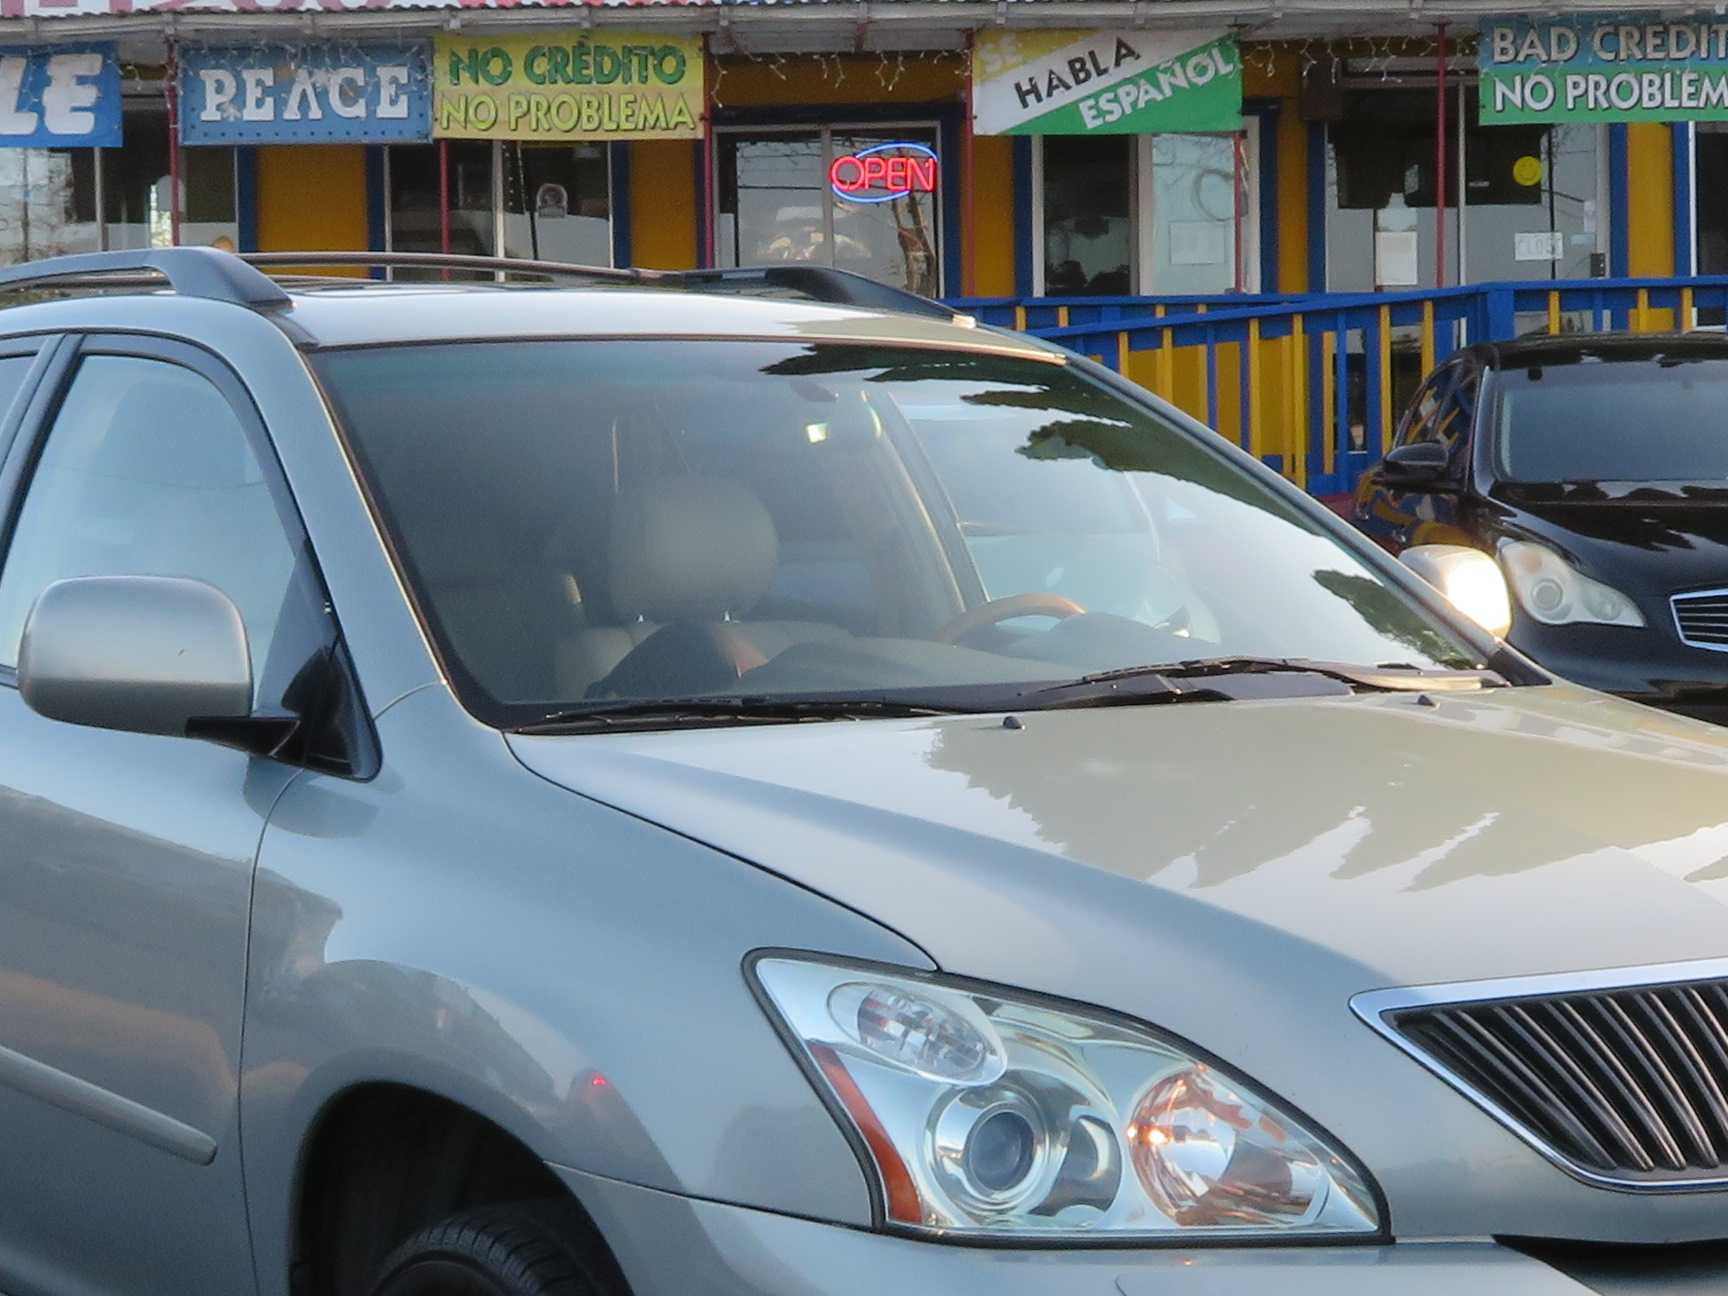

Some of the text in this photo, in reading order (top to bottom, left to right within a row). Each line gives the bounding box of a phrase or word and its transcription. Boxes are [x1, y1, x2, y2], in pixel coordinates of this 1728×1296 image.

[1491, 25, 1578, 63] BAD
[449, 47, 513, 86] NO
[1013, 37, 1141, 110] HABLA
[198, 65, 411, 122] PEACE
[1078, 47, 1234, 129] ESPAÑOL
[1493, 75, 1554, 112] NO
[441, 94, 696, 132] NO PROBLEMA
[829, 154, 937, 193] OPEN
